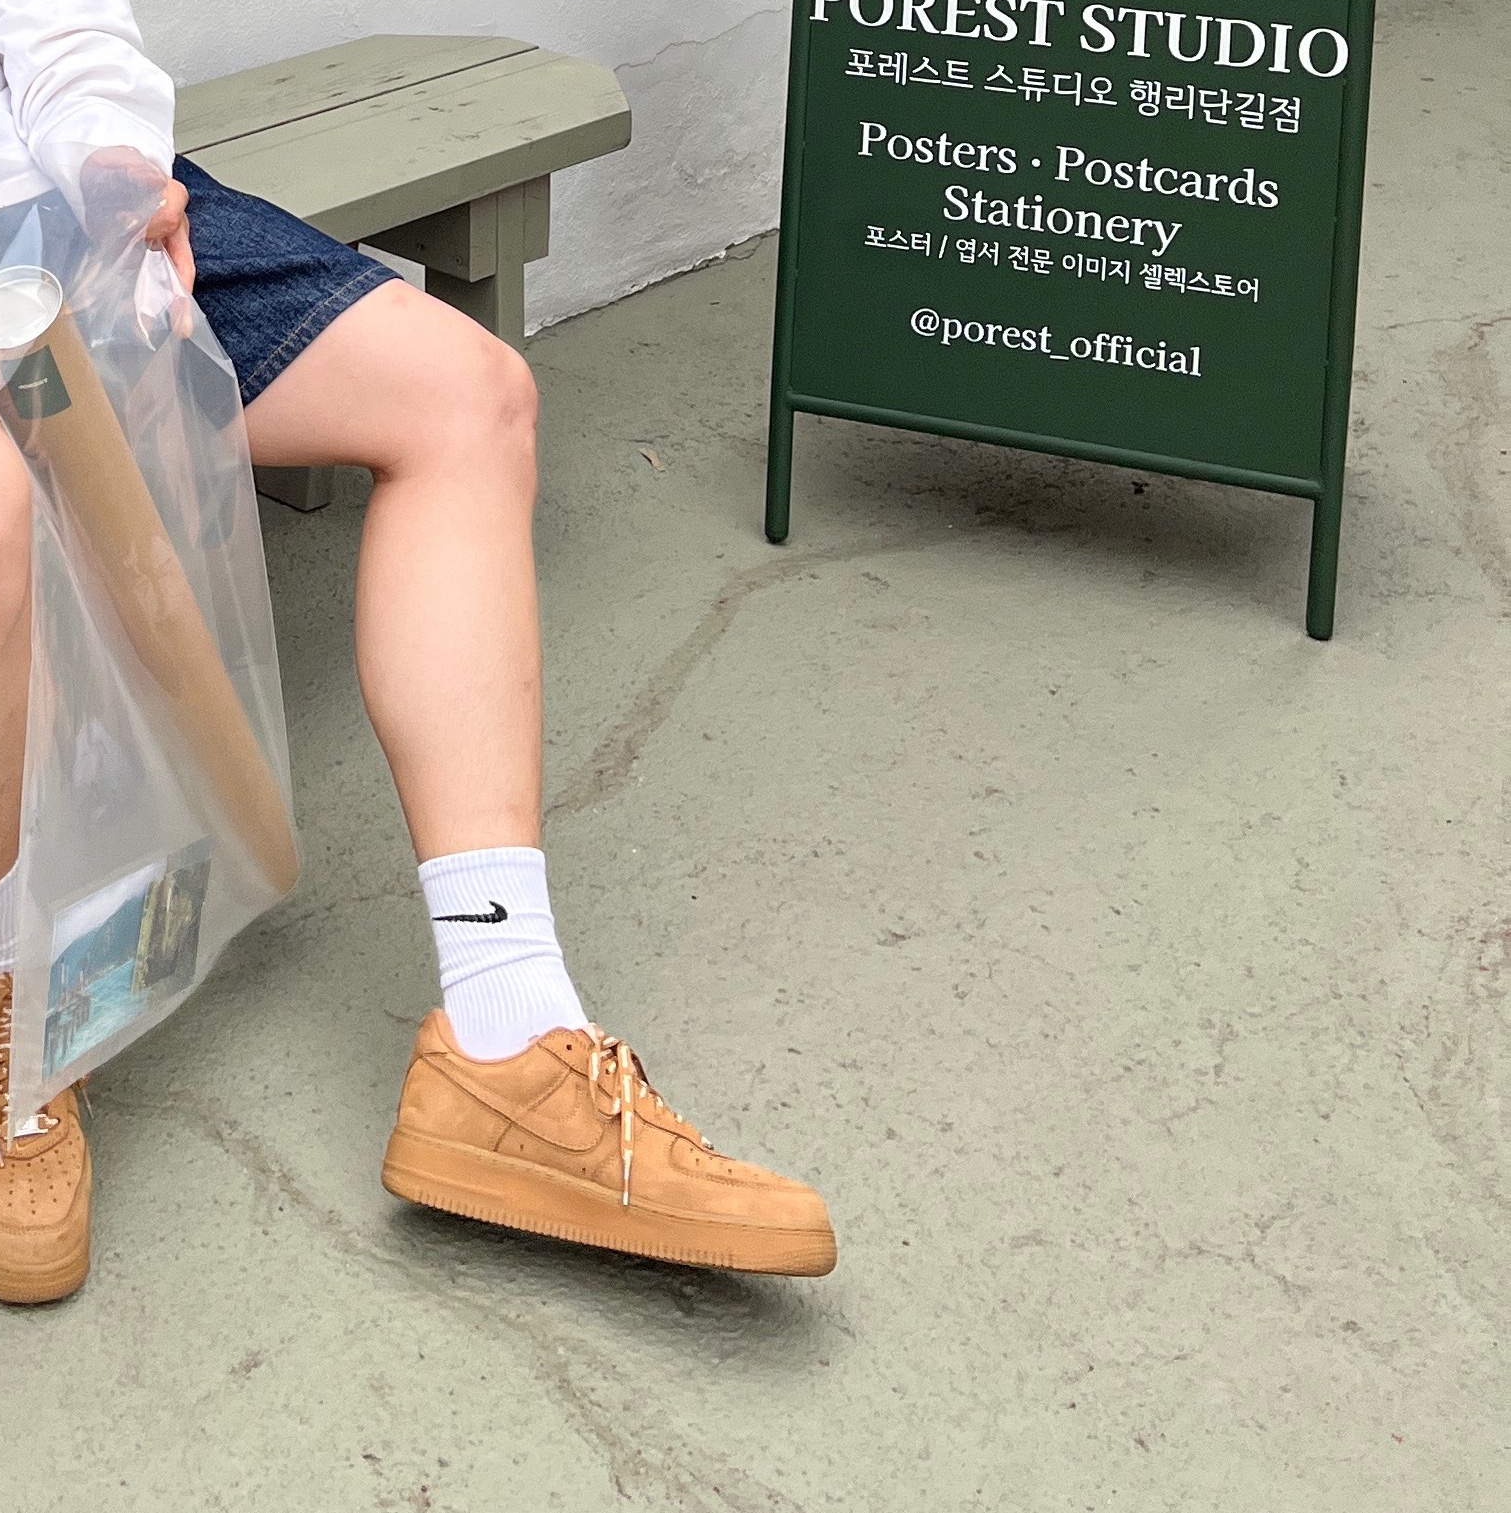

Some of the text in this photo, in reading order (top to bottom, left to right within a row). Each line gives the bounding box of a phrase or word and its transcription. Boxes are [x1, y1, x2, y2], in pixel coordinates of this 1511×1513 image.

[1080, 5, 1348, 77] STUDIO
[845, 49, 1300, 133] 포레스트 스튜디오 행리단길점
[858, 122, 1016, 173] Posters
[1055, 146, 1278, 207] Postcards
[944, 186, 1182, 256] Stationery
[865, 226, 930, 256] 포스터
[956, 239, 998, 266] 엽서
[1008, 246, 1053, 274] 전문
[1063, 254, 1130, 284] 이미지
[1140, 264, 1258, 302] 셀렉스토어
[911, 309, 1201, 376] @porest_official
